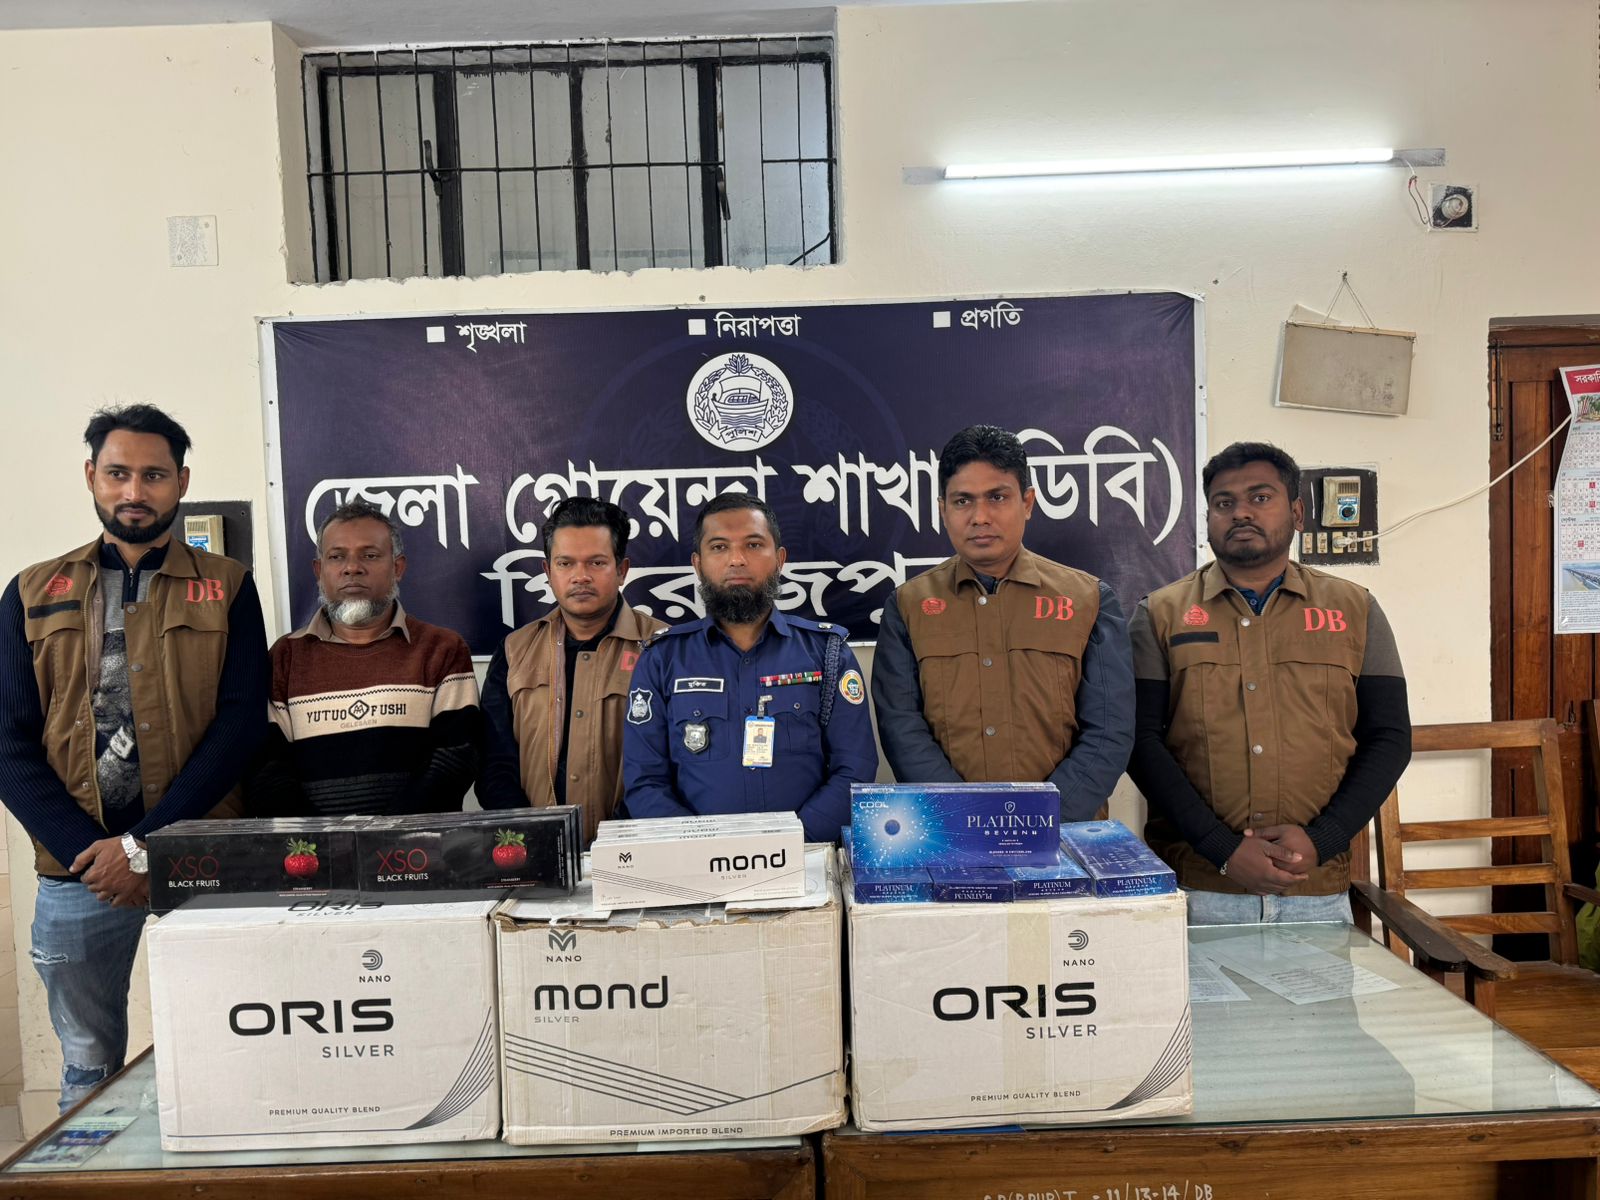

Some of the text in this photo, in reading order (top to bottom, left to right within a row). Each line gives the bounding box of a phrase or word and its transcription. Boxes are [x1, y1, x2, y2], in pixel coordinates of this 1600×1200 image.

[960, 301, 1024, 330] প্রগতি
[713, 311, 802, 338] নিরাপত্তা
[455, 321, 528, 353] শৃঙ্খলা
[185, 578, 225, 602] DB
[1033, 596, 1074, 620] DB
[1303, 607, 1347, 632] DB
[620, 650, 640, 672] D
[306, 709, 347, 723] YUTUO
[859, 801, 889, 809] COOL
[967, 814, 1054, 828] PLATINUM
[168, 855, 221, 880] XSO
[376, 848, 428, 873] XSO
[710, 848, 786, 873] mond
[168, 879, 221, 888] BLACK FRUITS
[377, 872, 429, 882] BLACK FRUITS
[1117, 877, 1156, 886] PLATINUM
[874, 884, 914, 892] PLATINUM
[1033, 881, 1071, 889] PLATINUM
[546, 955, 582, 963] NANO
[1063, 958, 1095, 967] NANO
[359, 975, 392, 983] NANO
[534, 975, 669, 1011] mond
[933, 982, 1097, 1021] ORIS
[229, 998, 394, 1036] ORIS
[534, 1016, 580, 1024] SILVER
[1026, 1024, 1098, 1040] SILVER
[322, 1044, 395, 1059] SILVER
[970, 1094, 1009, 1102] PREMIUM
[1013, 1092, 1050, 1100] QUALITY
[269, 1108, 308, 1116] PREMIUM
[311, 1106, 349, 1115] QUALITY
[610, 1127, 743, 1137] PREMIUM IMPORTED BLEND
